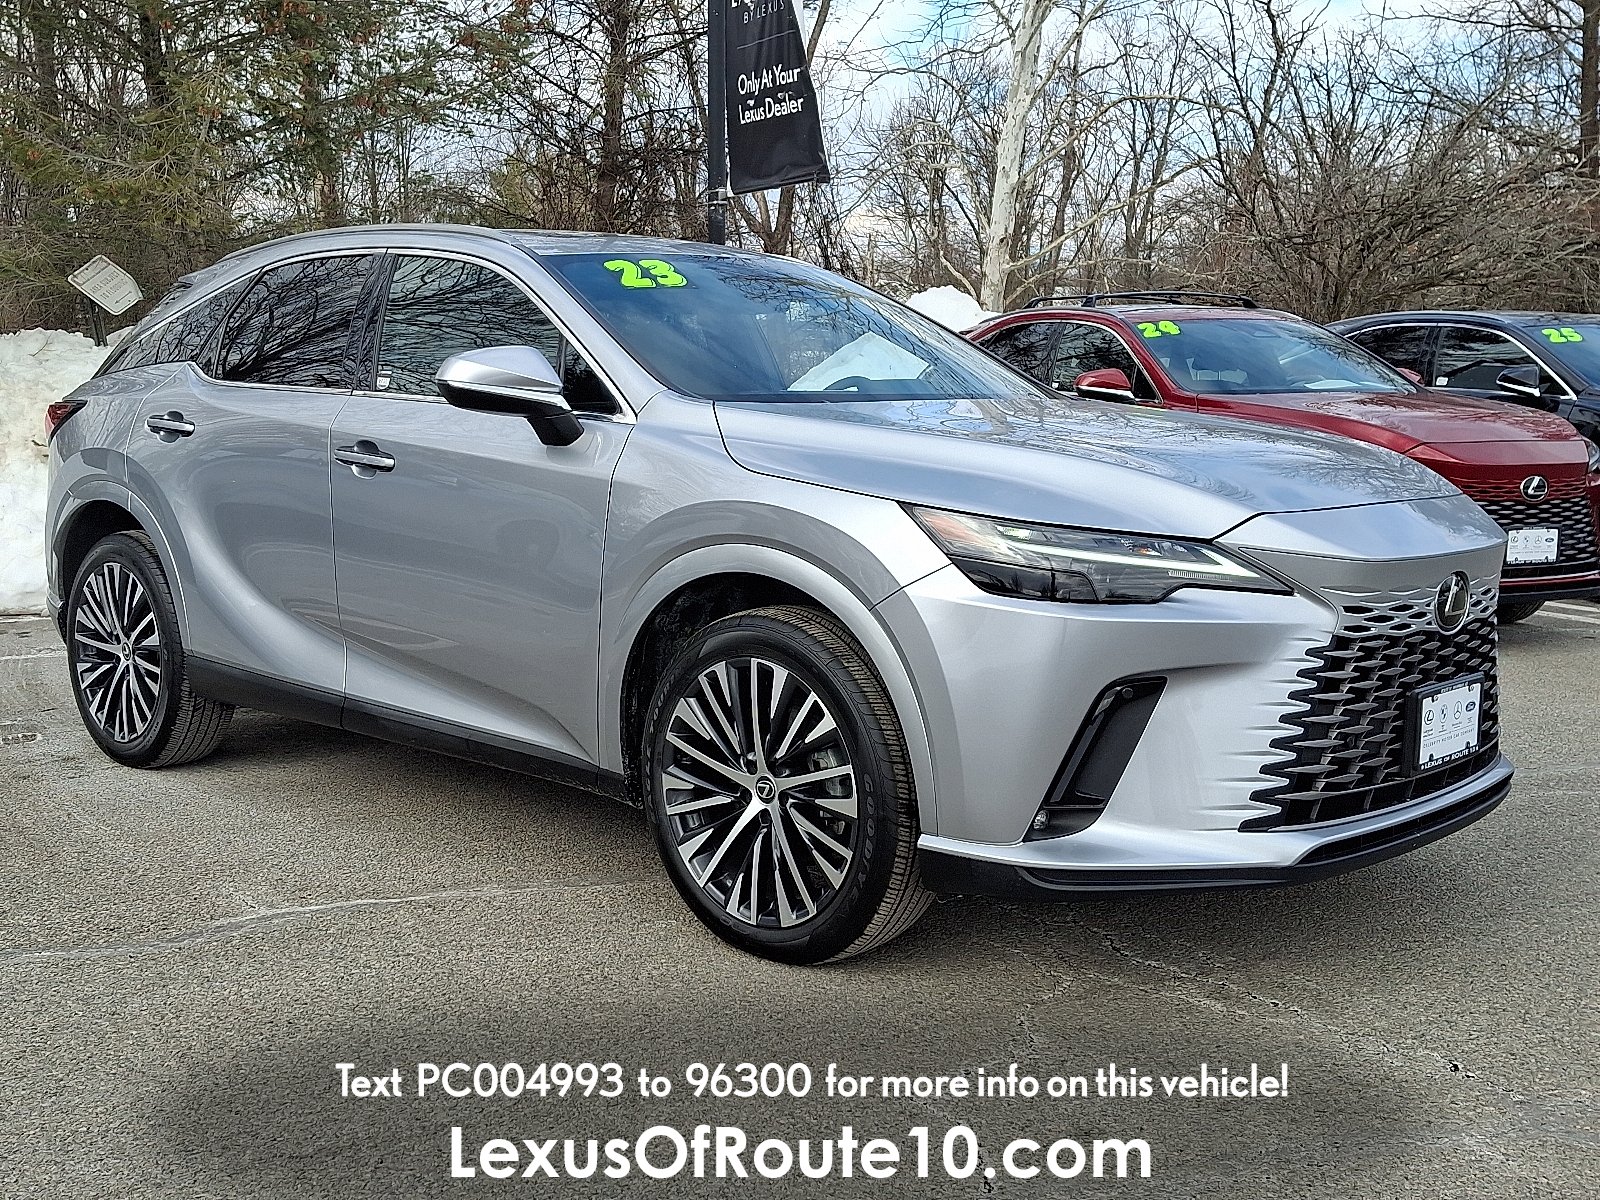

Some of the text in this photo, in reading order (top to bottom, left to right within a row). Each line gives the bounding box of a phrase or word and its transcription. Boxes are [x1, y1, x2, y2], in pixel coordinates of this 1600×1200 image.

[743, 10, 754, 24] BY
[757, 1, 785, 18] LEXUS
[738, 63, 801, 96] Only At Your
[738, 93, 804, 125] Lexus Dealer
[603, 259, 688, 288] 23
[1137, 320, 1181, 338] 24
[1541, 327, 1583, 343] 25
[1424, 758, 1443, 769] LEXUS
[1451, 749, 1469, 760] ROUTE
